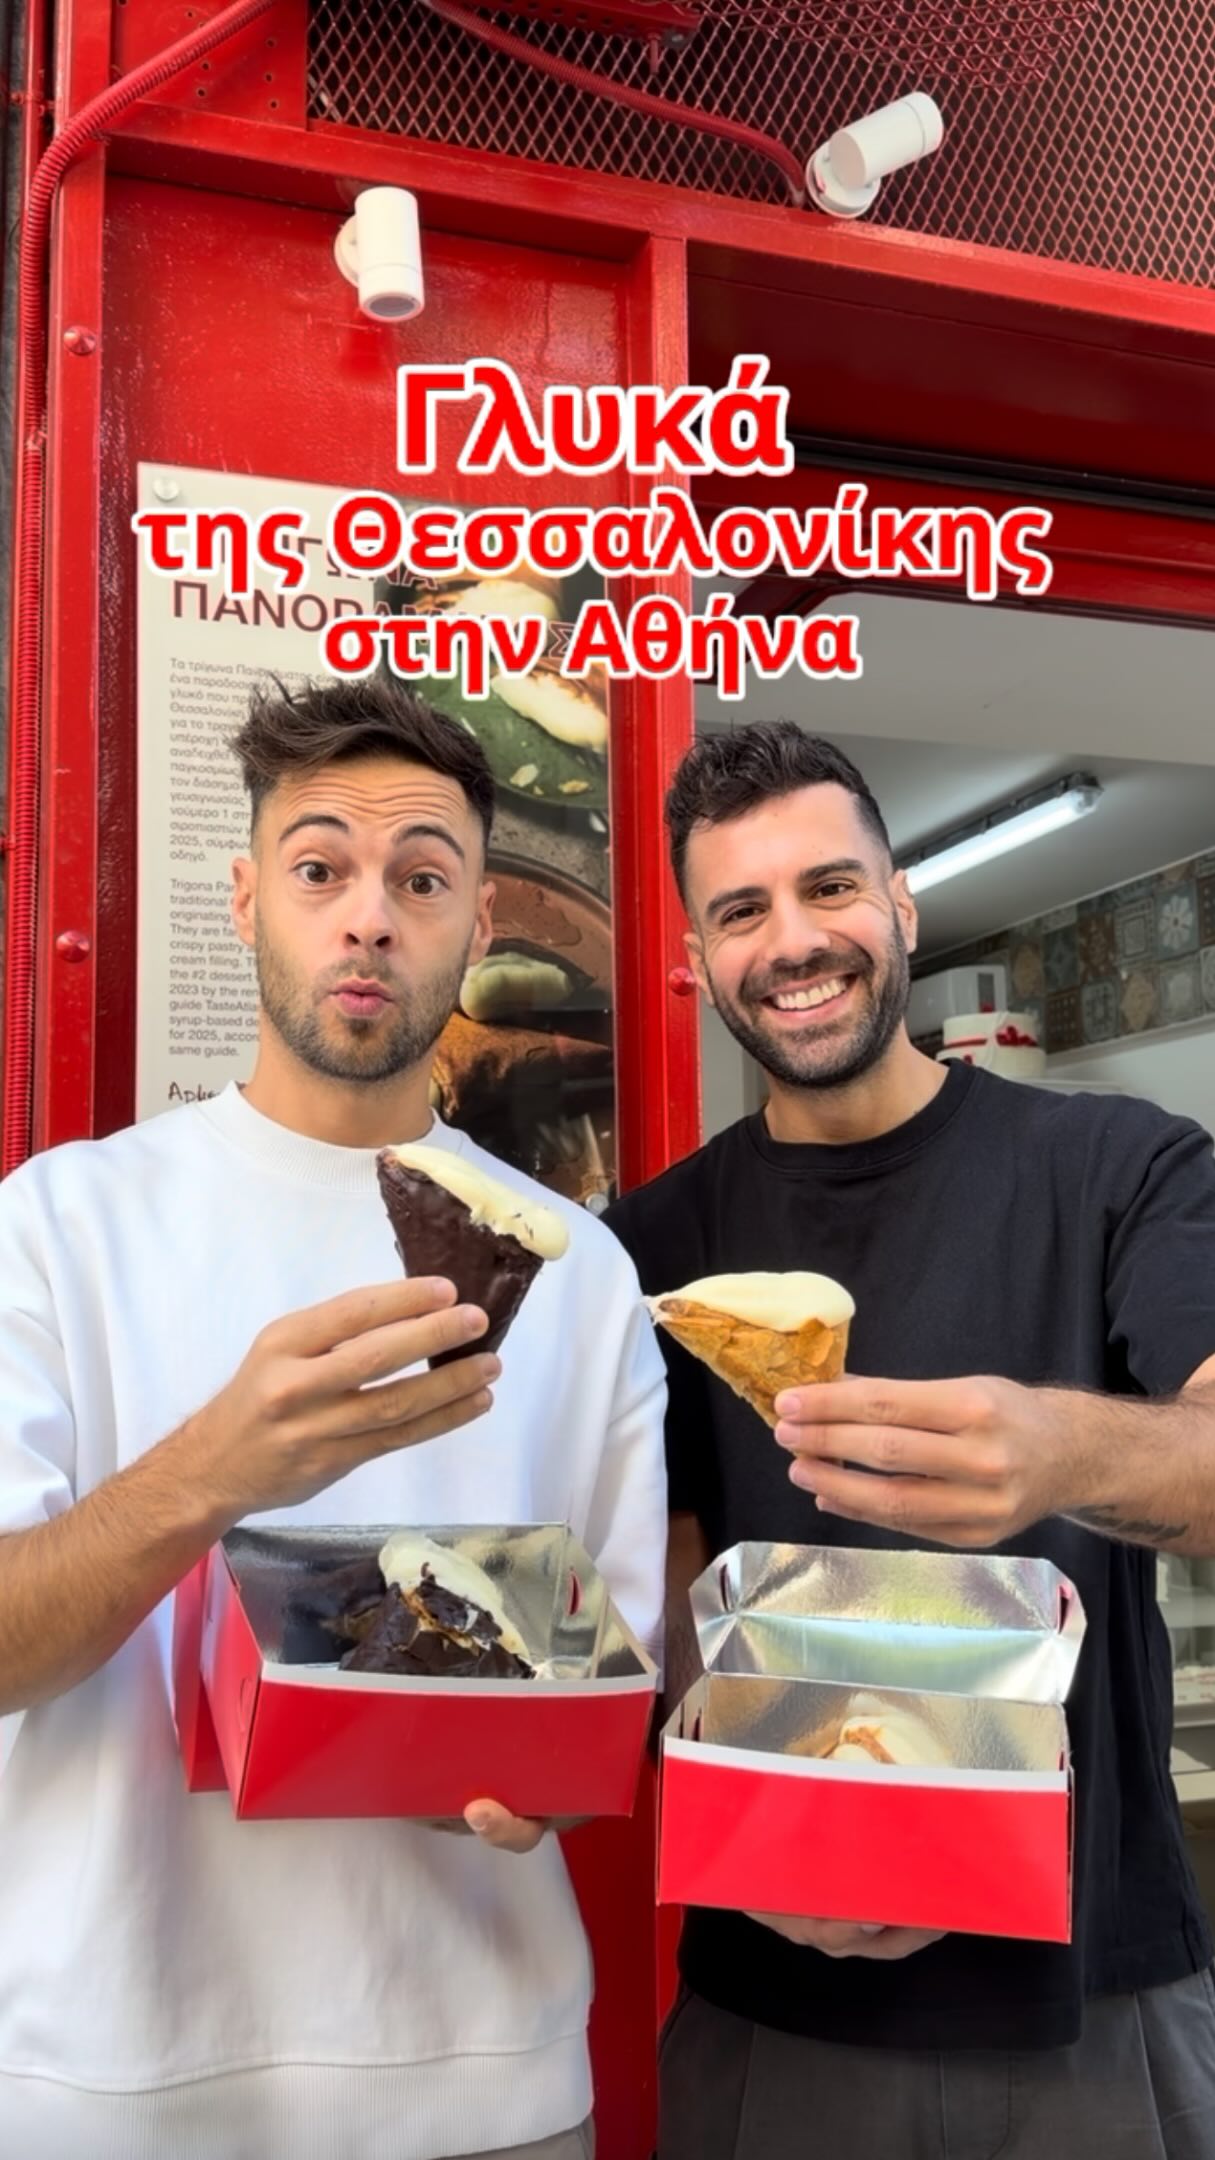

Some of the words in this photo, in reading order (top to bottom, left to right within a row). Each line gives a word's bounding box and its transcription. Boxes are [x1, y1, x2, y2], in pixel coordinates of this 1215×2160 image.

[170, 658, 186, 669] Τα
[170, 878, 213, 893] Trigona
[170, 894, 228, 906] traditional
[170, 910, 231, 924] originating
[170, 923, 199, 937] They
[202, 927, 221, 936] are
[170, 940, 205, 952] crispy
[208, 942, 244, 954] pastry
[170, 954, 207, 965] cream
[170, 969, 189, 979] the
[192, 969, 207, 980] #2
[209, 971, 252, 982] dessert
[170, 983, 199, 995] 2023
[202, 985, 217, 997] by
[220, 986, 239, 997] the
[170, 1000, 202, 1012] guide
[170, 1015, 243, 1027] syrup-based
[170, 1028, 186, 1039] for
[188, 1029, 222, 1042] 2025,
[170, 1045, 202, 1055] same
[204, 1045, 241, 1059] guide.
